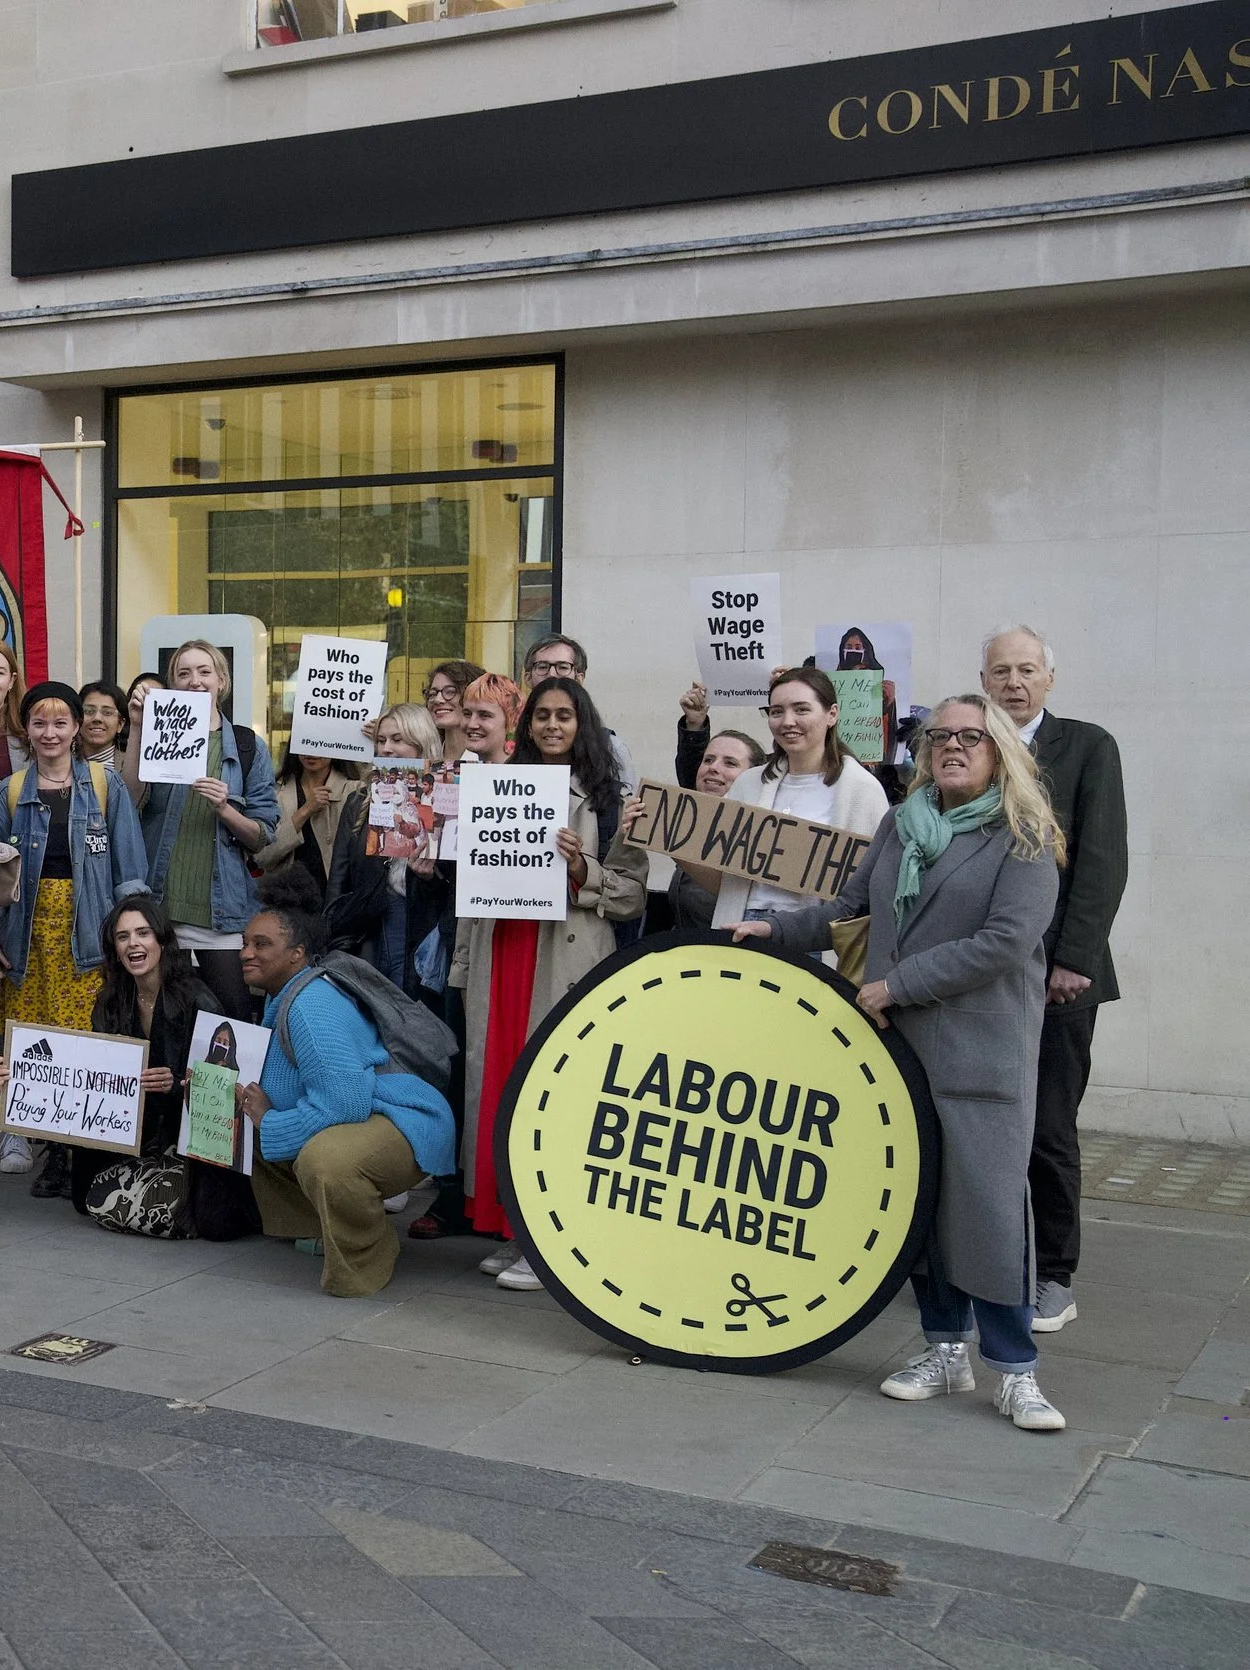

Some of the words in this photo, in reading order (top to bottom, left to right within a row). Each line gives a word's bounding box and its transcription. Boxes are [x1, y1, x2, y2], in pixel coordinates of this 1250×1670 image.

[827, 43, 1080, 141] CONDÉ
[1107, 38, 1250, 106] NAS
[711, 590, 759, 612] Stop
[707, 615, 765, 638] Wage
[327, 648, 360, 664] Who
[710, 641, 765, 661] Theft
[308, 667, 344, 683] pays
[348, 670, 373, 685] the
[851, 678, 871, 692] ME
[312, 687, 345, 701] cost
[348, 689, 366, 702] of
[154, 705, 198, 730] made
[303, 701, 369, 721] fashion?
[160, 731, 184, 746] my
[301, 738, 365, 752] #PayYourWorkers
[144, 738, 206, 760] clothes?
[493, 779, 536, 796] Who
[471, 805, 517, 823] pays
[523, 803, 555, 820] the
[478, 828, 520, 843] cost
[526, 826, 547, 843] of
[628, 784, 697, 852] END
[701, 802, 798, 881] WAGE
[800, 825, 870, 896] THE
[470, 848, 555, 867] fashion?
[470, 896, 553, 907] #PayYourWorkers
[22, 1051, 53, 1062] adidas
[12, 1060, 70, 1086] IMPOSSIBLE
[73, 1068, 83, 1088] IS
[86, 1070, 138, 1097] NOTHING
[7, 1082, 46, 1123] Paying
[50, 1087, 78, 1123] Your
[600, 1043, 840, 1148] LABOUR
[586, 1100, 828, 1209] BEHIND
[583, 1164, 668, 1221] THE
[676, 1187, 817, 1261] LABEL
